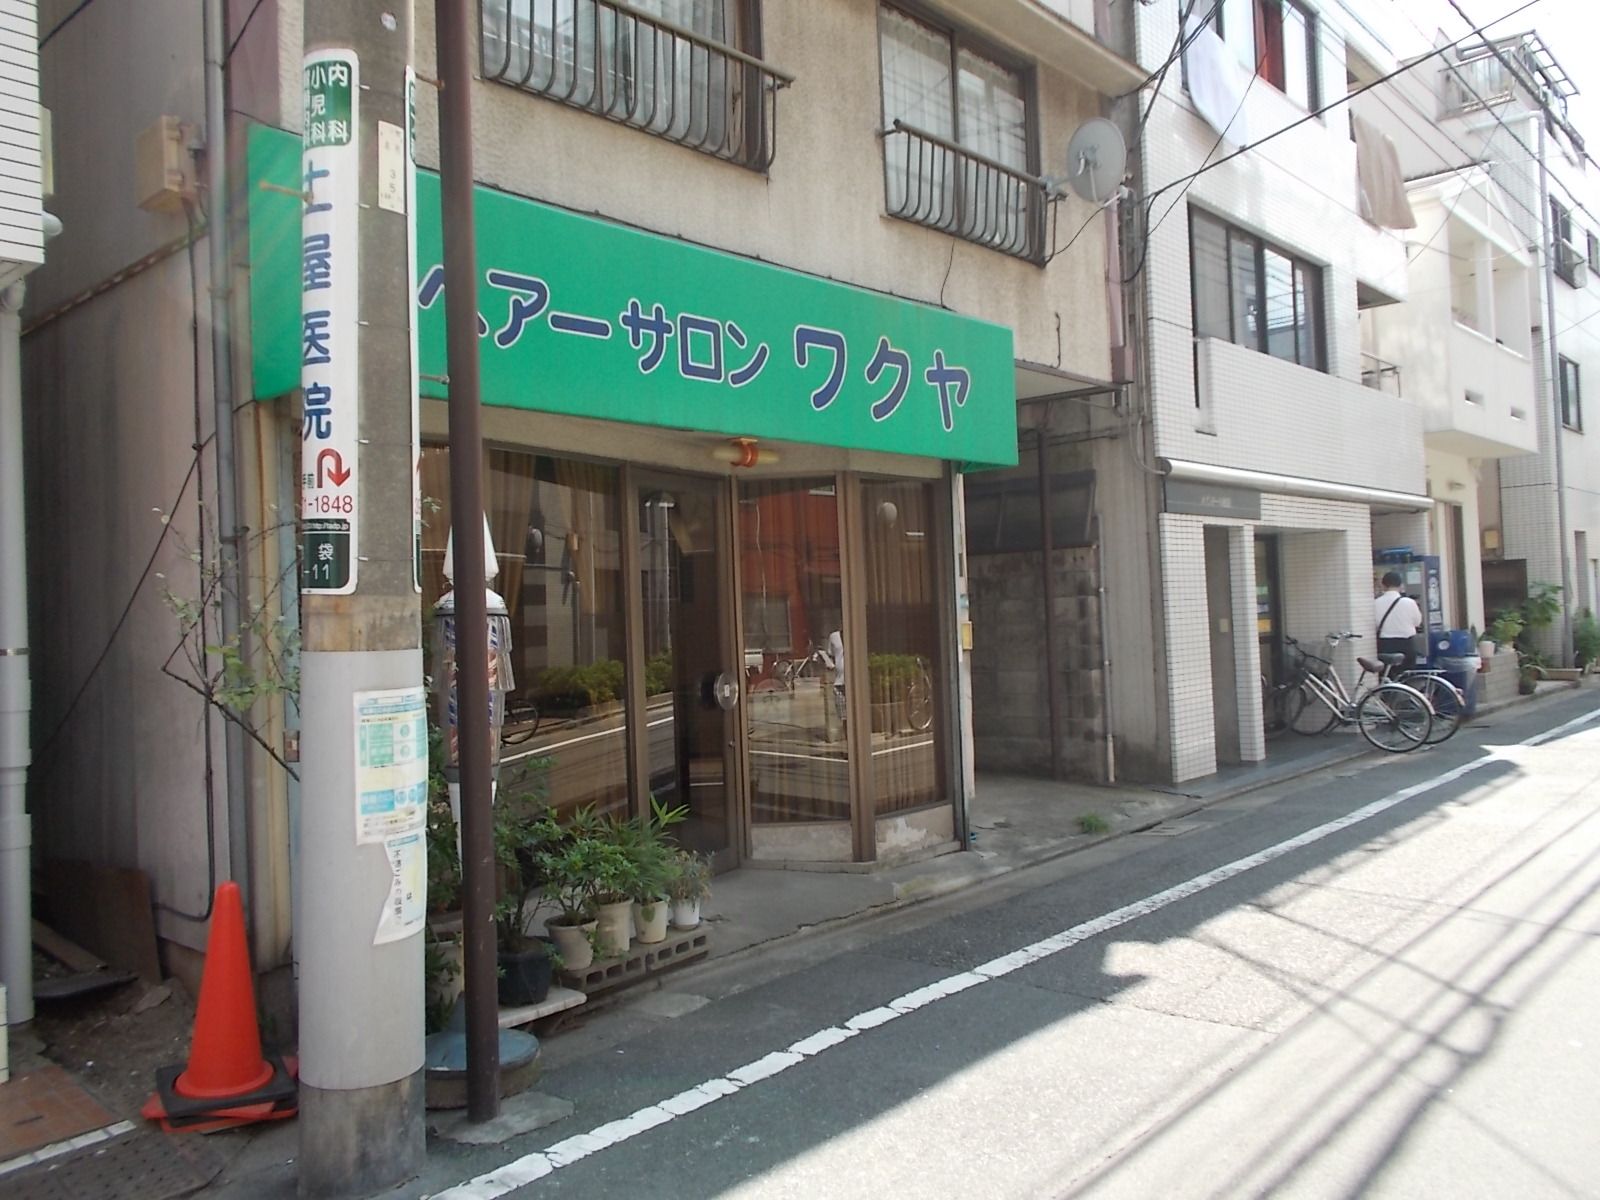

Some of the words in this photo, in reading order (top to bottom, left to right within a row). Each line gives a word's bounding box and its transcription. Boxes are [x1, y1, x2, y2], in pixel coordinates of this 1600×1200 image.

[310, 65, 327, 145] 小児科
[327, 63, 349, 143] 内科
[794, 325, 971, 432] ワクヤ
[318, 542, 335, 561] 袋
